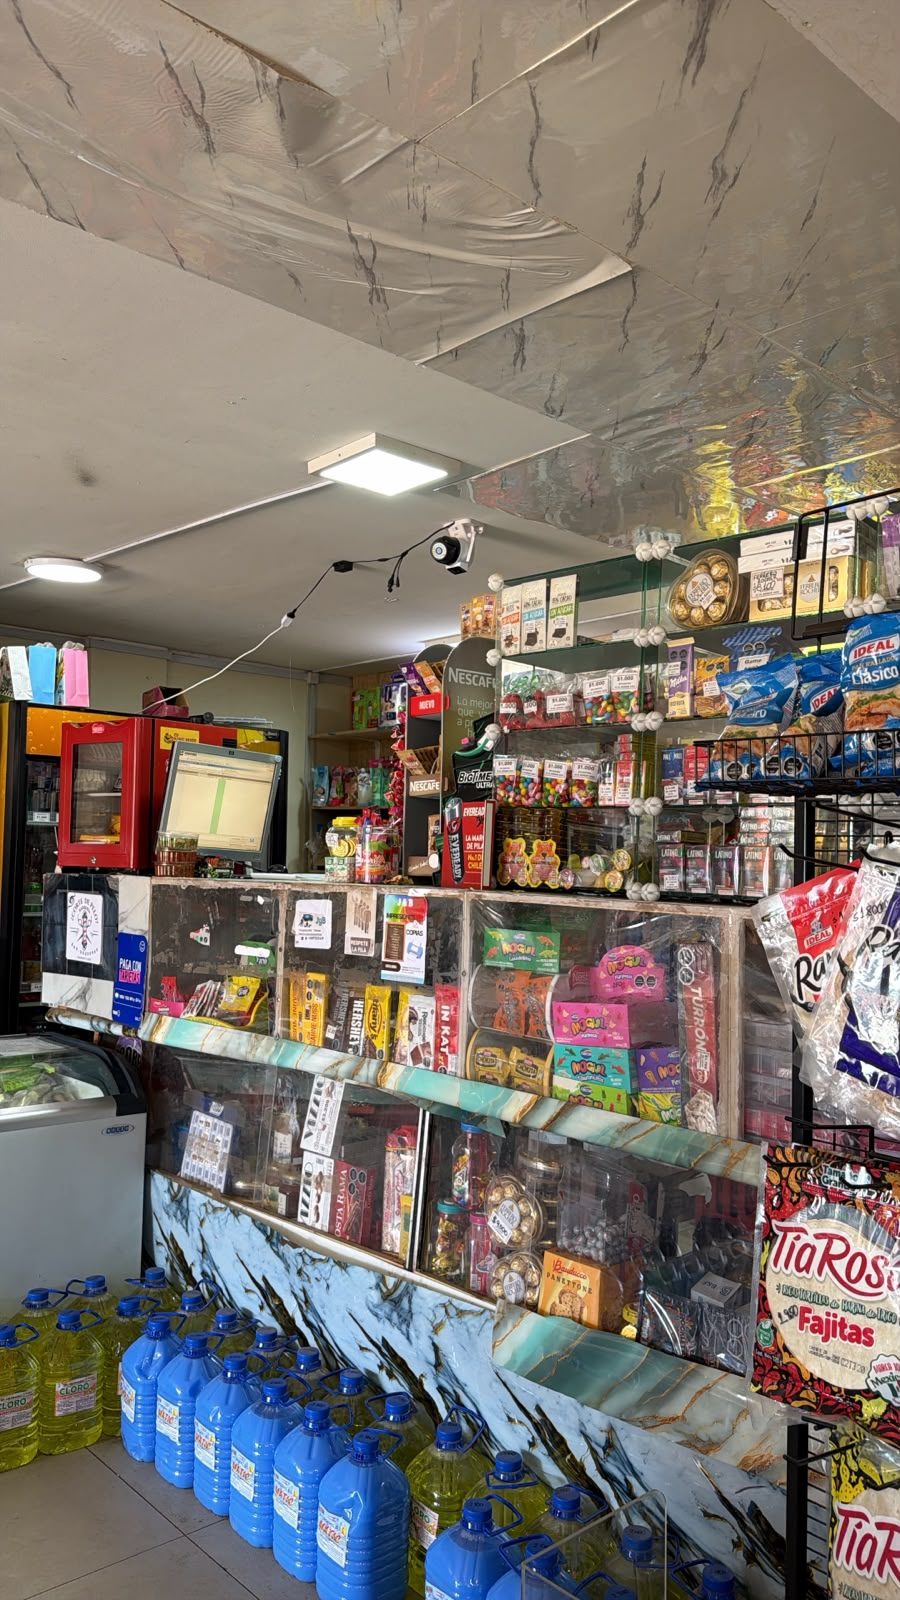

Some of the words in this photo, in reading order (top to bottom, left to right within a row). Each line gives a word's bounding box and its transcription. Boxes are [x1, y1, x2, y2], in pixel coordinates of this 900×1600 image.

[853, 639, 895, 659] IDEAL
[463, 807, 486, 817] EVEREAD
[450, 834, 462, 878] EVEREADY
[406, 929, 424, 937] COPIAS
[805, 930, 832, 947] IDEAL
[501, 943, 536, 957] MOGUL
[120, 958, 132, 970] PAGA
[132, 961, 142, 972] CON
[607, 955, 647, 976] MOGUL
[441, 1005, 451, 1022] IN
[571, 1017, 607, 1035] MOGUL
[440, 1025, 451, 1056] KAT
[571, 1060, 607, 1078] MOGUL
[553, 1257, 588, 1280] Bauducco
[546, 1271, 593, 1295] PANETTONE
[799, 1288, 830, 1306] TORTILLAS
[841, 1299, 866, 1316] HARINA
[877, 1306, 898, 1325] TRIGO
[798, 1305, 875, 1348] Fajitas
[59, 1382, 91, 1397] CLORO
[413, 1507, 431, 1525] ORO
